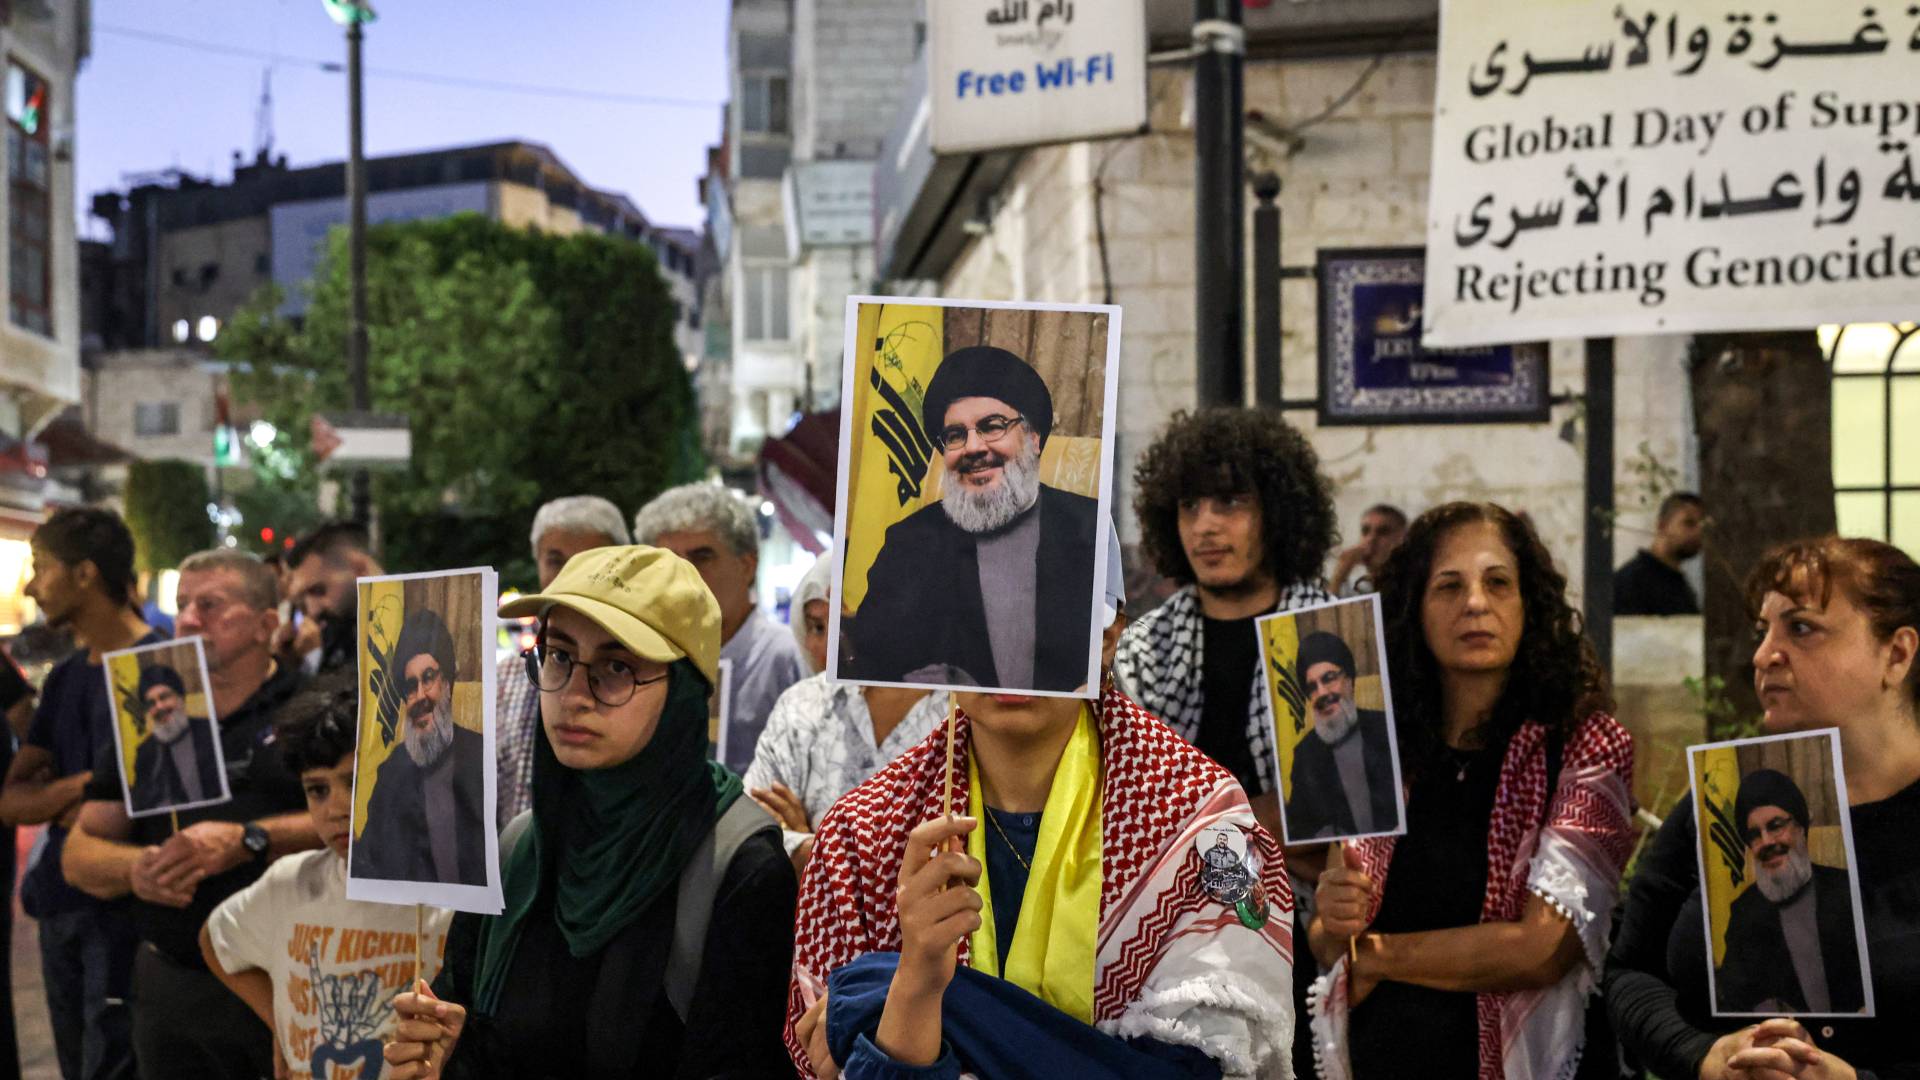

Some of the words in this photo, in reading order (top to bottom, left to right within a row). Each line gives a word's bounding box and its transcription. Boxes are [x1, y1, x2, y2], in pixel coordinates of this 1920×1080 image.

[1468, 4, 1711, 98] والأسرى
[1725, 7, 1890, 70] غزة
[957, 70, 1026, 99] Free
[1035, 52, 1113, 90] Wi-Fi
[1464, 113, 1613, 164] Global
[1633, 108, 1726, 155] Day
[1742, 91, 1796, 134] of
[1454, 164, 1628, 249] الأسرى
[1455, 253, 1668, 313] Rejecting
[1684, 234, 1920, 290] Genocide
[288, 922, 334, 966] JUST
